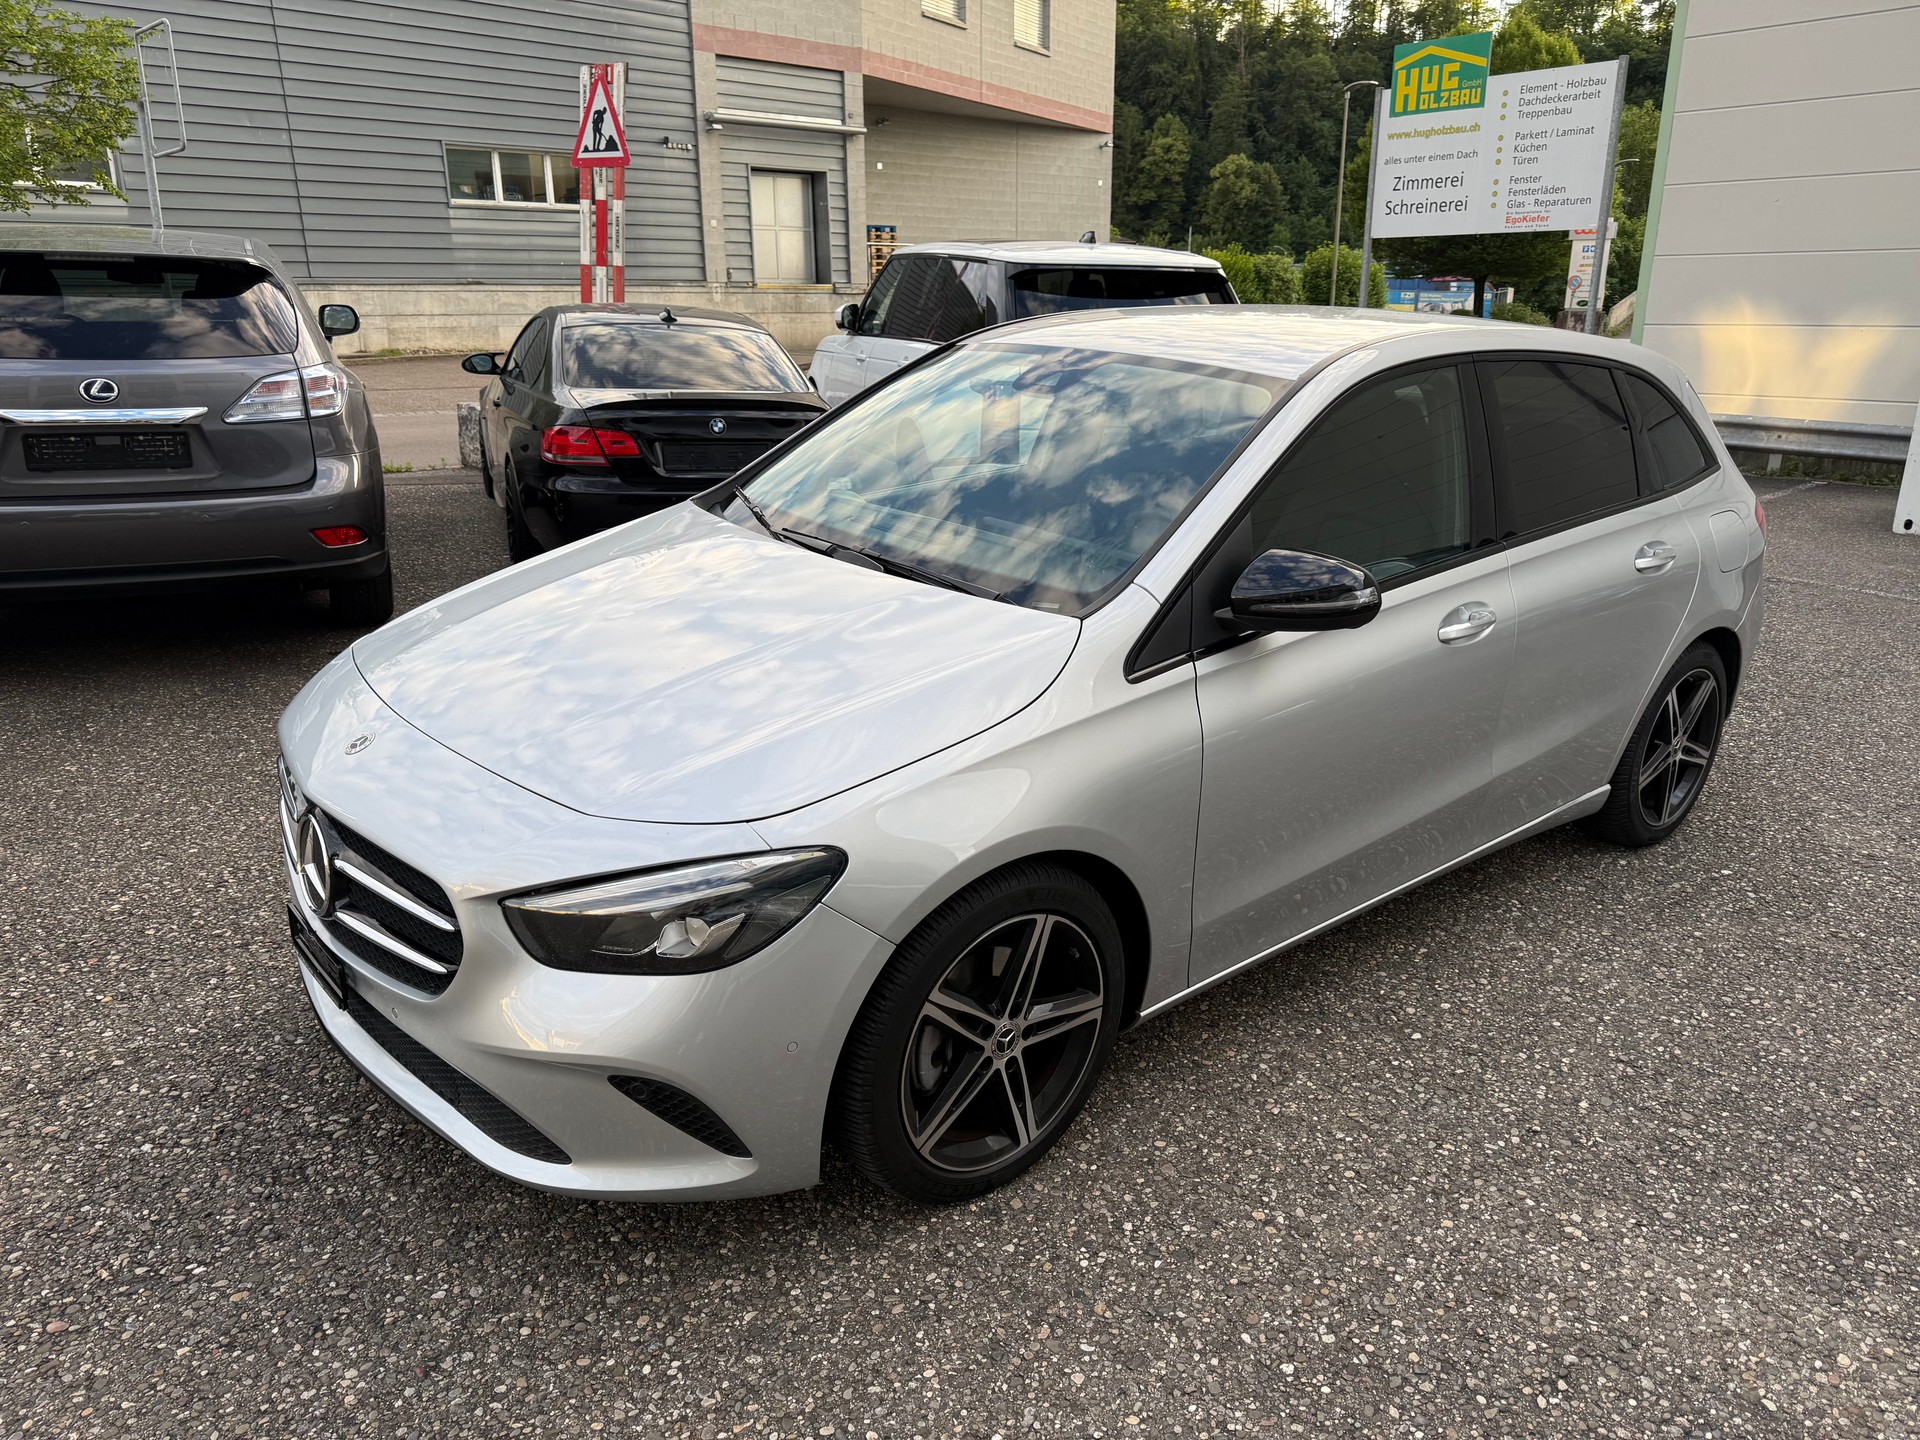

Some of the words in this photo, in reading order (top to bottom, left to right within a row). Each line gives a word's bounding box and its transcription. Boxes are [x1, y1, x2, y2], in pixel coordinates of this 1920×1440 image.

[1395, 62, 1460, 112] HUG
[1462, 79, 1482, 88] GmbH
[1520, 82, 1558, 94] Element
[1566, 76, 1607, 89] Holzbau
[1518, 89, 1601, 107] Dachdeckerarbeit
[1517, 106, 1572, 120] Treppenbau
[1387, 122, 1480, 140] www.hugholzbau.ch
[1515, 130, 1548, 141] Parkett
[1556, 125, 1595, 137] Laminat
[1513, 142, 1547, 153] Küchen
[1384, 156, 1402, 165] alles
[1404, 154, 1426, 164] unter
[1428, 152, 1454, 161] einem
[1456, 149, 1478, 160] Dach
[1512, 156, 1538, 165] Türen
[1392, 171, 1464, 191] Zimmerei
[1509, 175, 1542, 185] Fenster
[1508, 185, 1566, 197] Fensterläden
[1385, 195, 1468, 216] Schreinerei
[1506, 199, 1526, 209] Glas
[1533, 196, 1592, 209] Reparaturen
[1505, 214, 1550, 225] EgoKiefer
